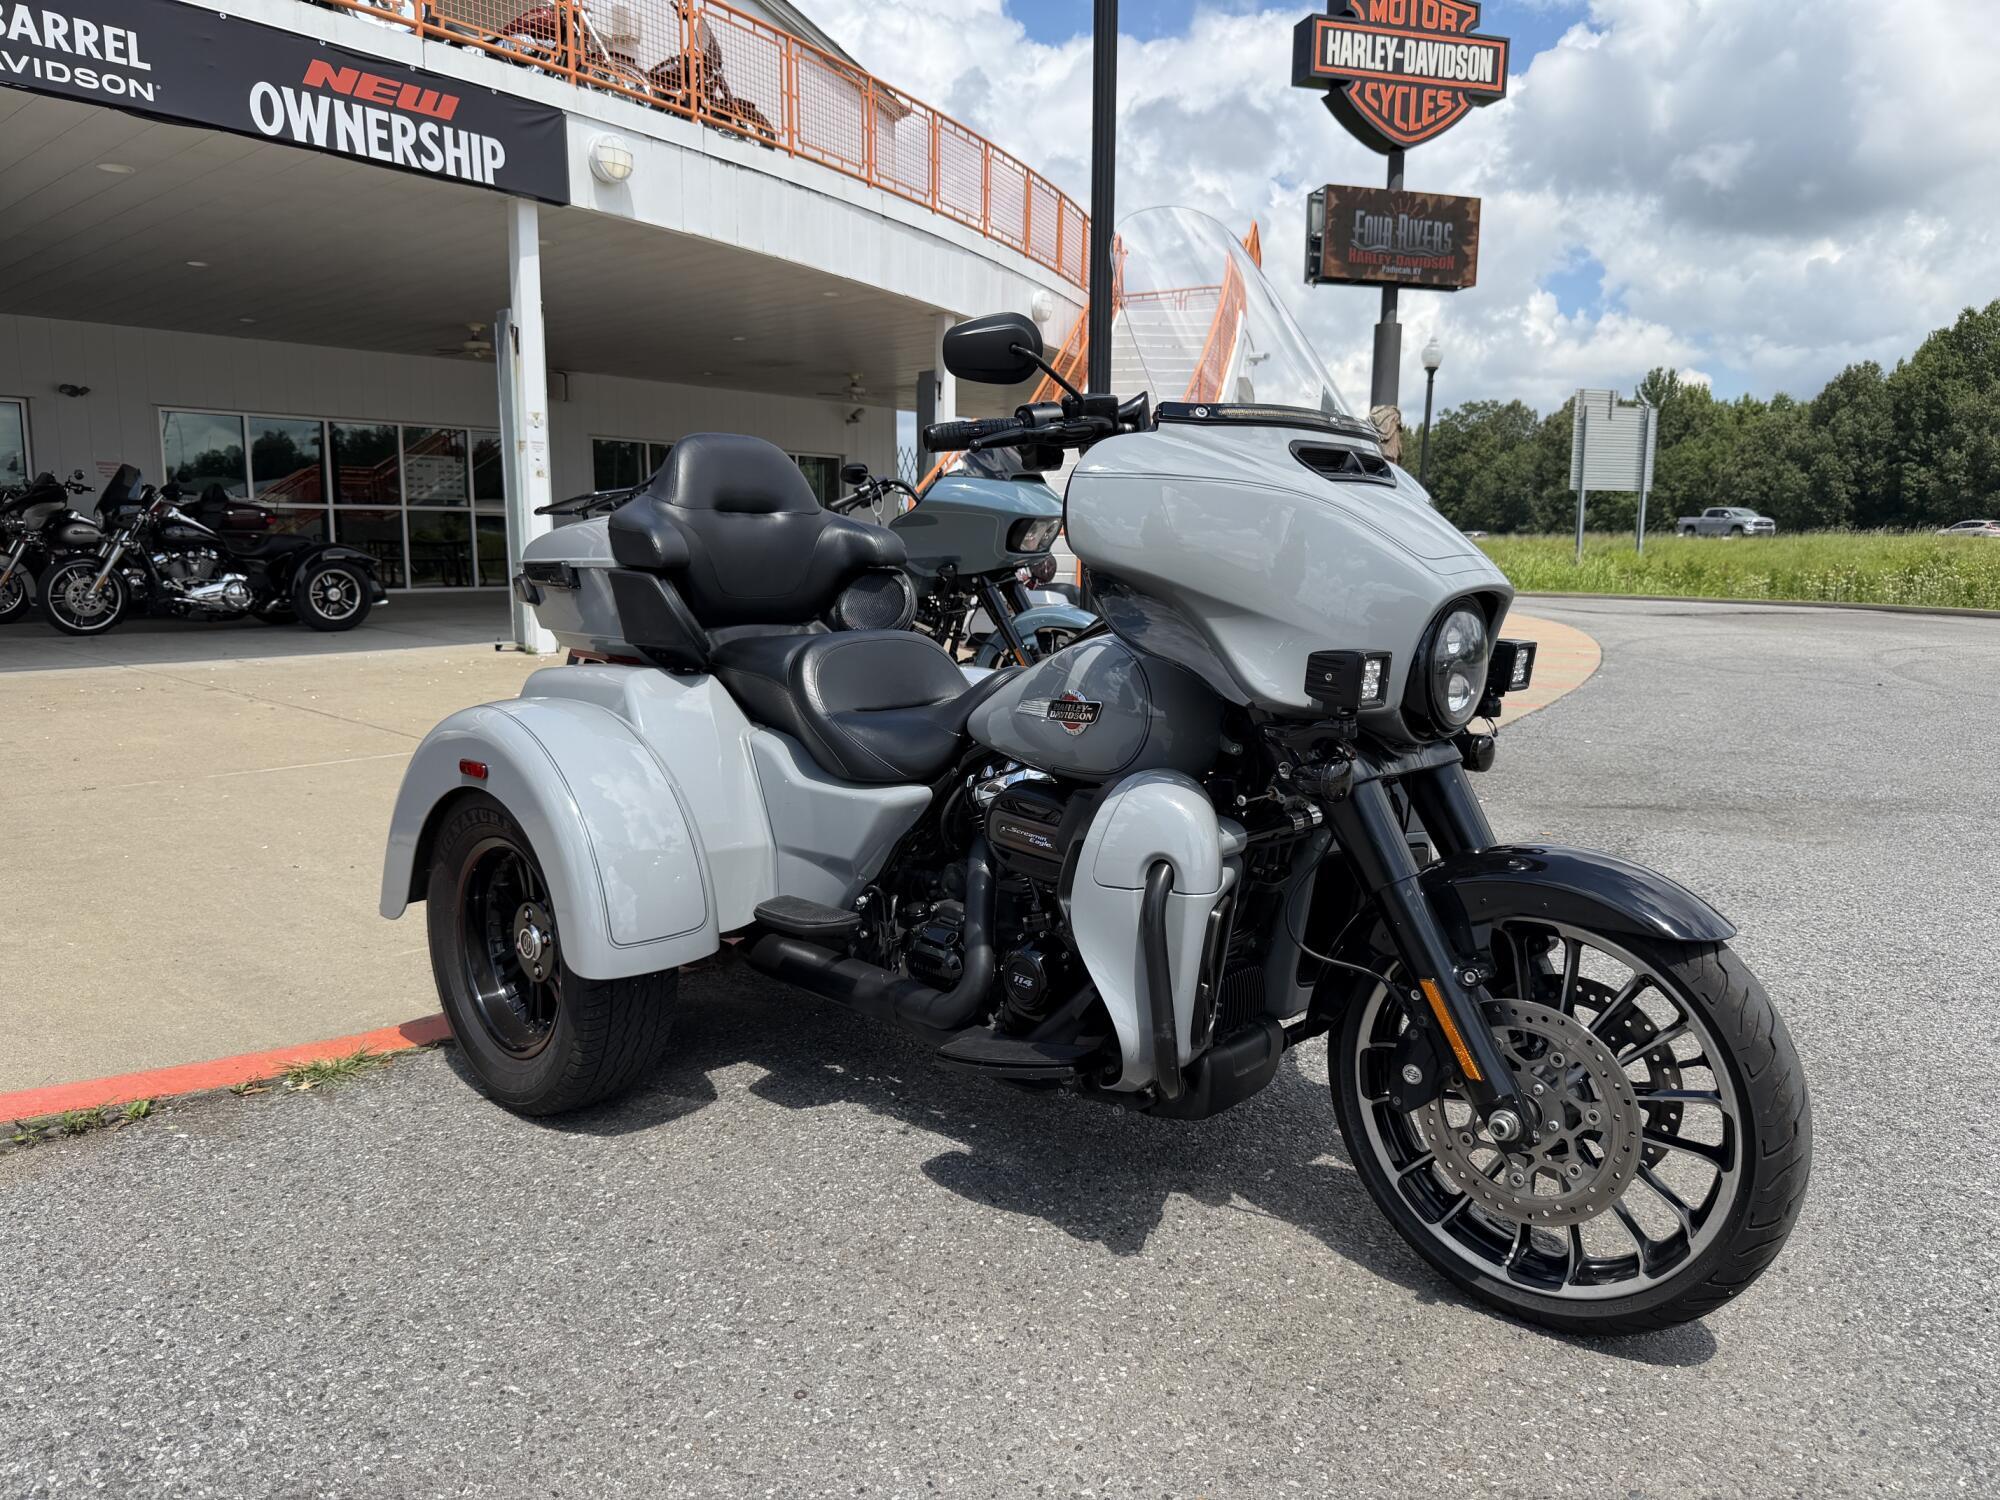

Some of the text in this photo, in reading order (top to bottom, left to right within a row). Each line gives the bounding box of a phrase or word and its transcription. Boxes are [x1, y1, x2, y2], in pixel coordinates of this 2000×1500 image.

[1369, 0, 1458, 33] MOTOR
[1326, 29, 1494, 83] HARLEY-DAVIDSON
[302, 58, 460, 121] NEW
[1365, 82, 1453, 132] CYCLES
[249, 81, 506, 185] OWNERSHIP
[1050, 711, 1094, 721] DAVIDSON
[1013, 975, 1033, 987] 114
